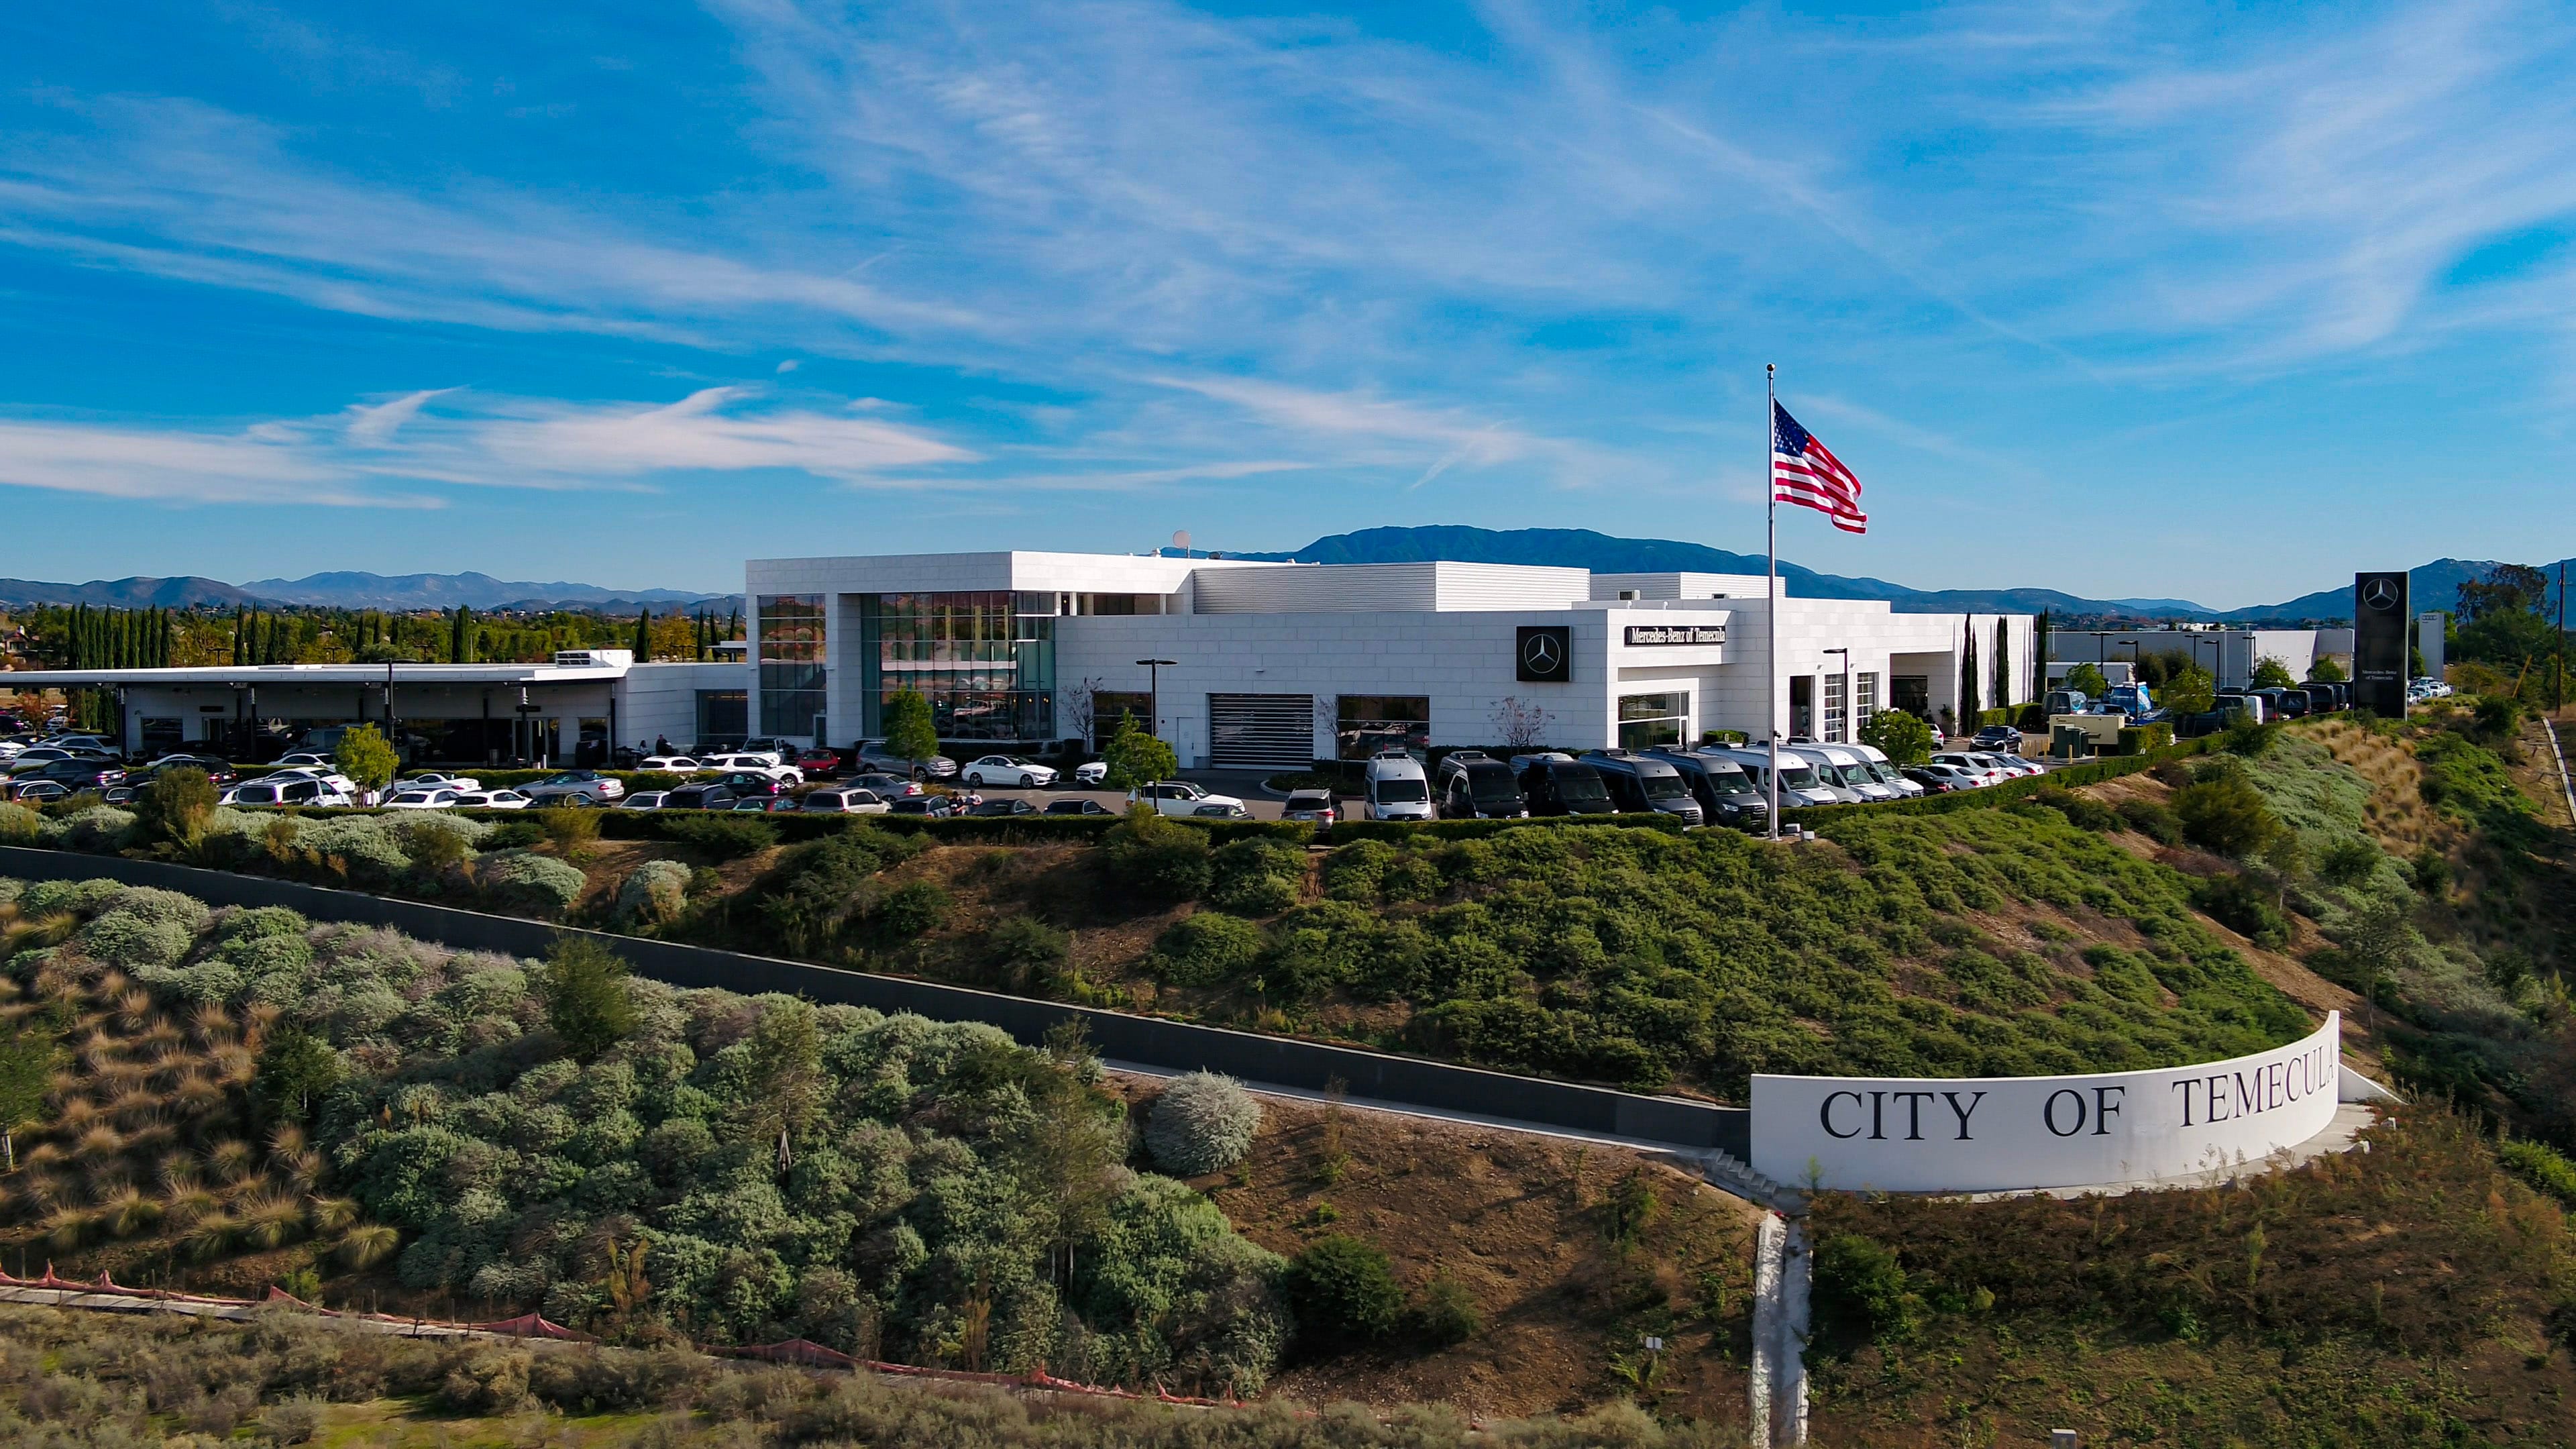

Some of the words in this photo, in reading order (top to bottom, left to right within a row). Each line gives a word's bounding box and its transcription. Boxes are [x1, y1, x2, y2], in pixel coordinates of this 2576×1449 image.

[1631, 627, 1684, 643] Mercedes-Benz
[1686, 628, 1694, 642] of
[1695, 627, 1725, 642] Temecula
[1820, 1091, 1988, 1140] CITY
[2043, 1085, 2125, 1136] OF
[2171, 1040, 2334, 1128] TEMECULA
